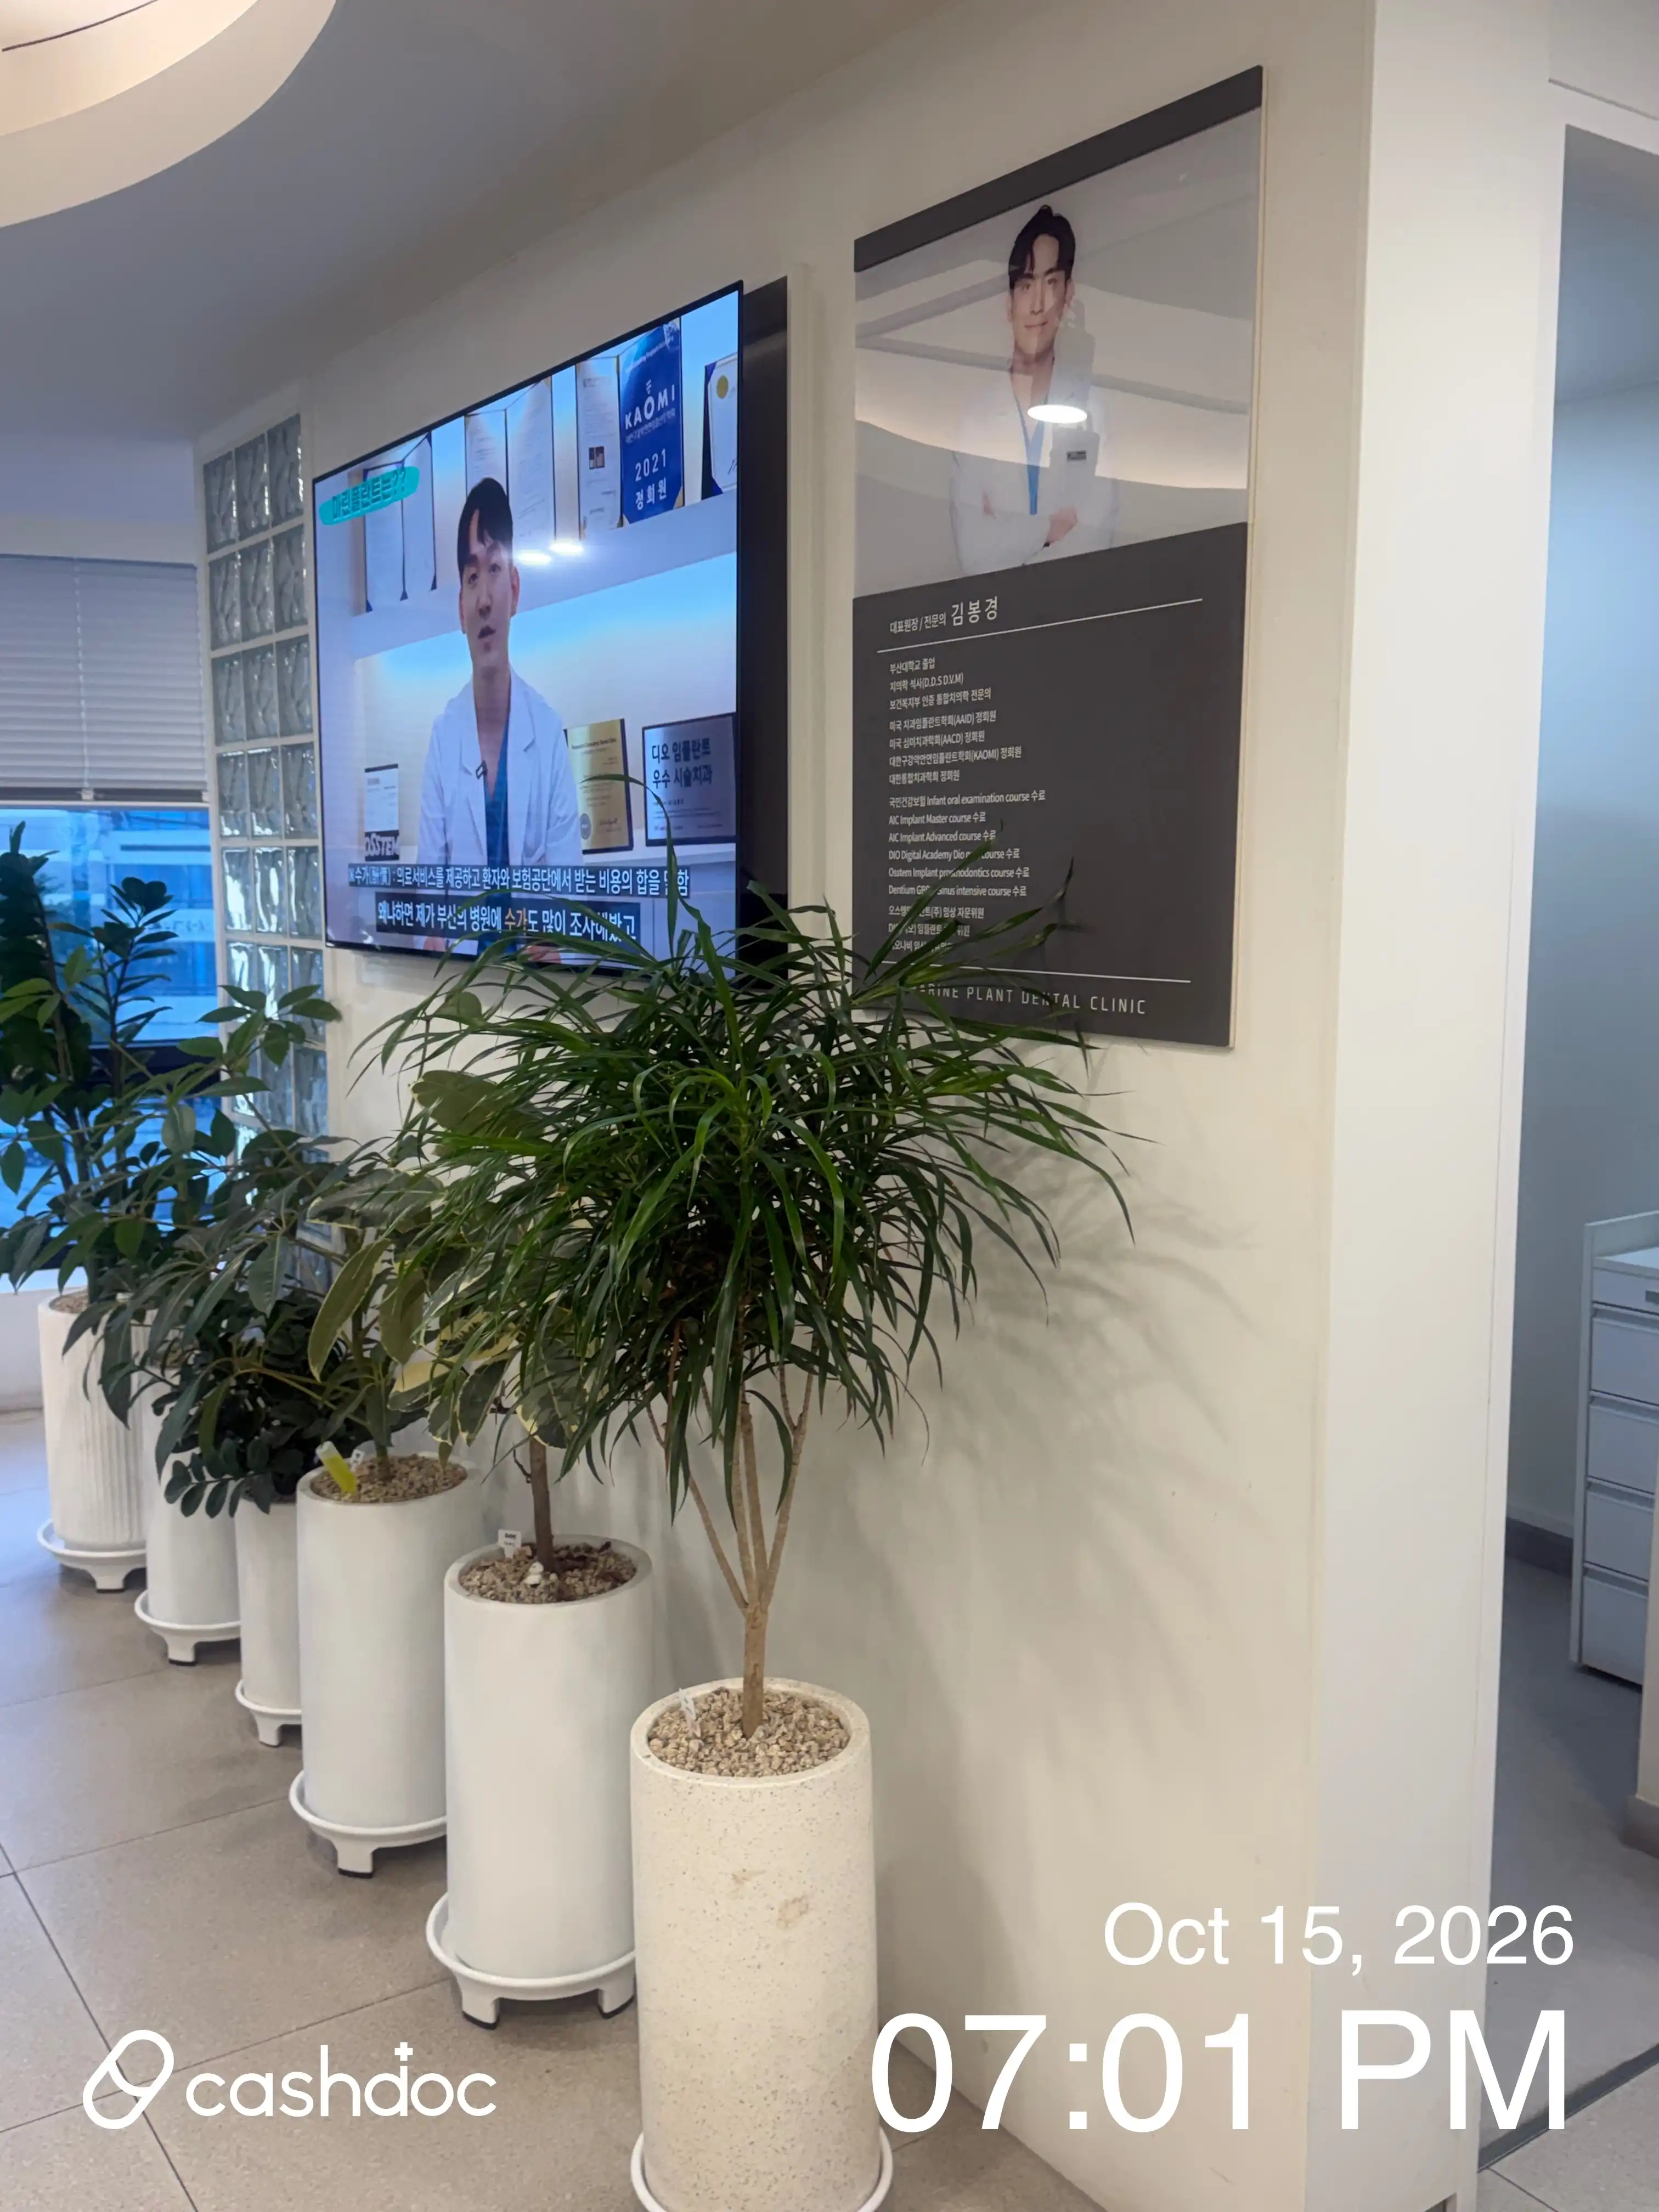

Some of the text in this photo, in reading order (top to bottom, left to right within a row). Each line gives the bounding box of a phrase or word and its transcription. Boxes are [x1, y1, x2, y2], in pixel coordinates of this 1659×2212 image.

[625, 384, 675, 430] KAOMI
[635, 448, 667, 482] 2021
[635, 477, 667, 511] 정회원
[951, 596, 998, 627] 김봉경
[889, 657, 935, 675] 부산대학교 졸업
[889, 687, 992, 710] 보건복지부 인증 통합치의학 전문의
[889, 720, 902, 732] 미국
[975, 710, 997, 723] 정회원
[652, 737, 712, 764] 디오 임플란트
[889, 730, 985, 750] 미국 심미치과학회(AACD) 정회원
[1000, 746, 1022, 759] 정회원
[652, 764, 713, 789] 우수 시술치과
[889, 769, 960, 785] 대한통합치과학회 정회원
[889, 789, 1046, 809] 국민건강보험 Infant oral examination course 수료
[888, 811, 986, 826] AIC Implant Master course 수료
[888, 830, 996, 844] AIC Implant Advanced course 수료
[889, 850, 901, 860] DIO
[901, 849, 921, 862] Digital
[922, 850, 952, 862] Academy
[953, 849, 965, 859] Dio
[1005, 848, 1020, 860] 수료
[397, 867, 444, 888] 의료서비스를
[445, 867, 481, 889] 제공하고
[482, 867, 510, 890] 환자와
[512, 867, 572, 893] 보험공단에서
[574, 868, 596, 894] 받는
[599, 868, 633, 895] 비용의
[636, 868, 661, 895] 합을
[889, 868, 912, 877] Osstem
[912, 867, 938, 879] Implant
[990, 869, 1014, 878] course
[1015, 867, 1030, 878] 수료
[889, 884, 916, 895] Dentium
[956, 885, 988, 896] intensive
[988, 887, 1012, 896] course
[1012, 885, 1027, 897] 수료
[416, 903, 435, 928] 제가
[470, 905, 502, 933] 병원에
[504, 907, 539, 935] 수가도
[943, 906, 957, 918] 임상
[957, 907, 985, 919] 자문위원
[967, 986, 1013, 1003] PLANT
[1090, 996, 1146, 1015] CLINIC
